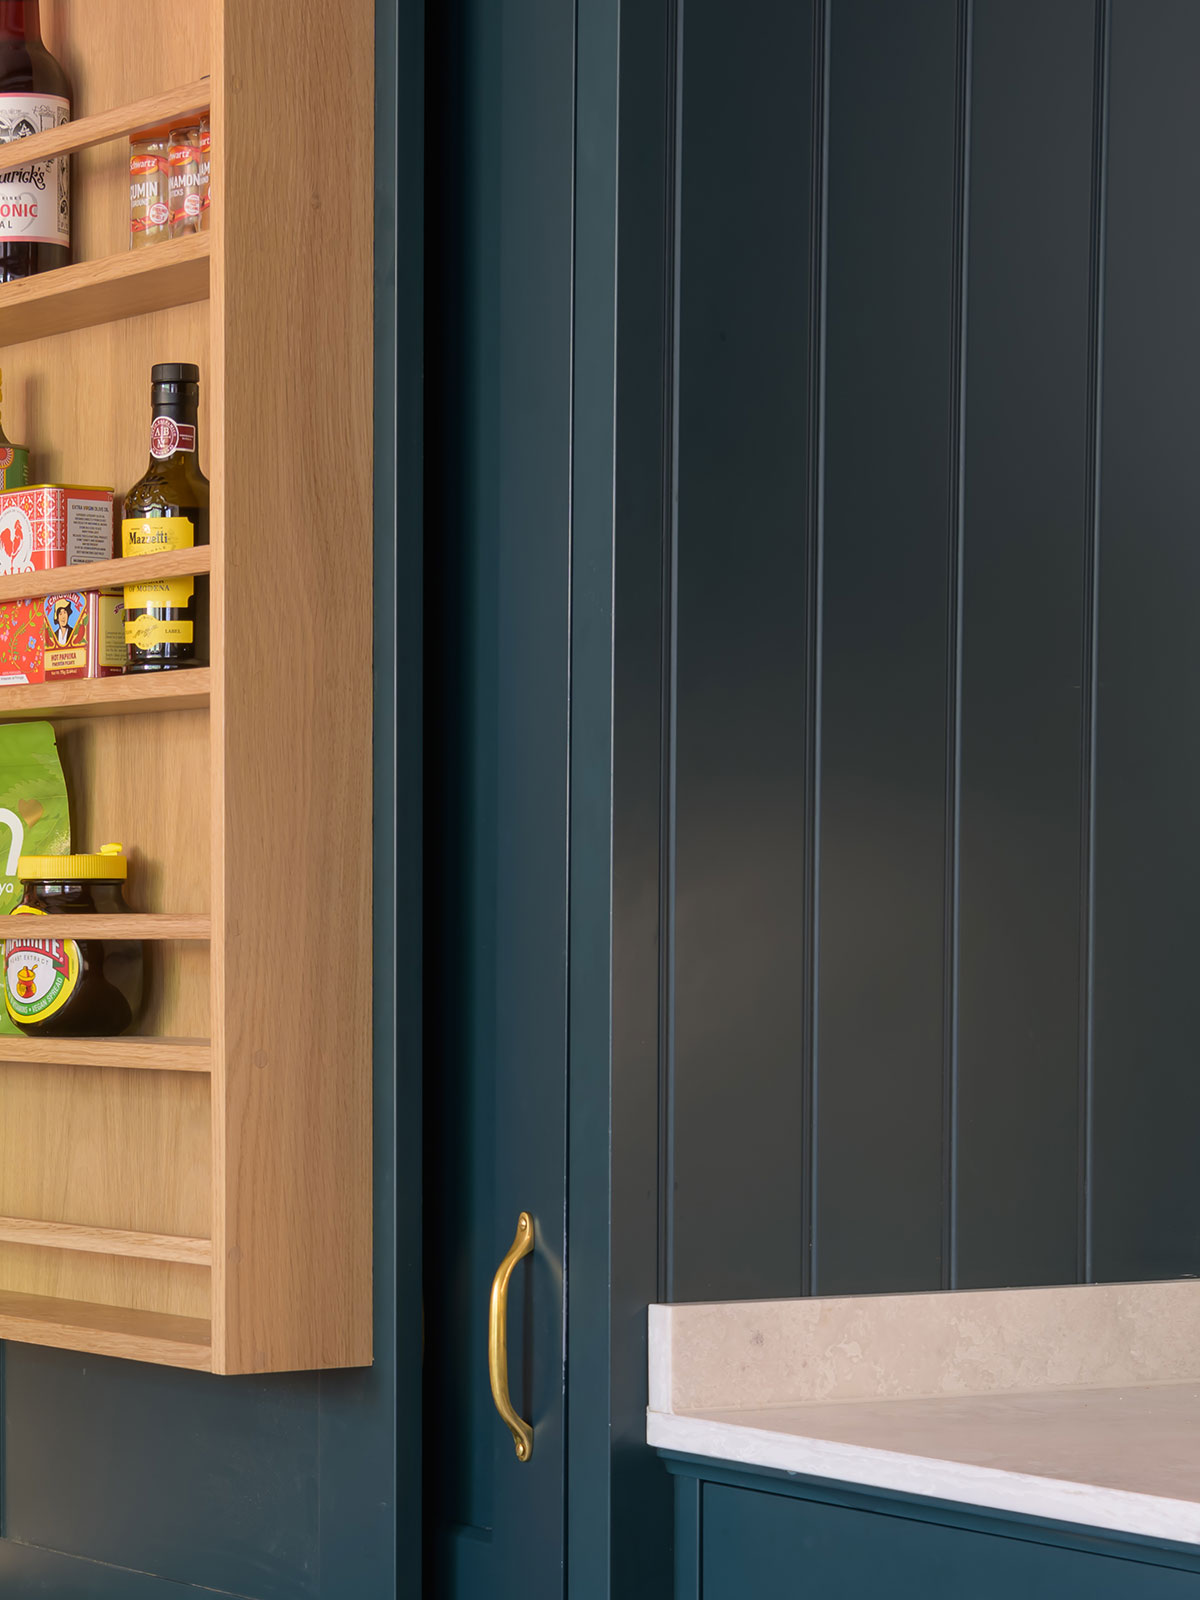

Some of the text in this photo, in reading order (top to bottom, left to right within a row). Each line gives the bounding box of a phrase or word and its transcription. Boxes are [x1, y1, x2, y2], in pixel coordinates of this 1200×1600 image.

[128, 530, 168, 545] Mazzetti
[136, 584, 170, 592] MODENA
[47, 977, 63, 1002] SPREAD
